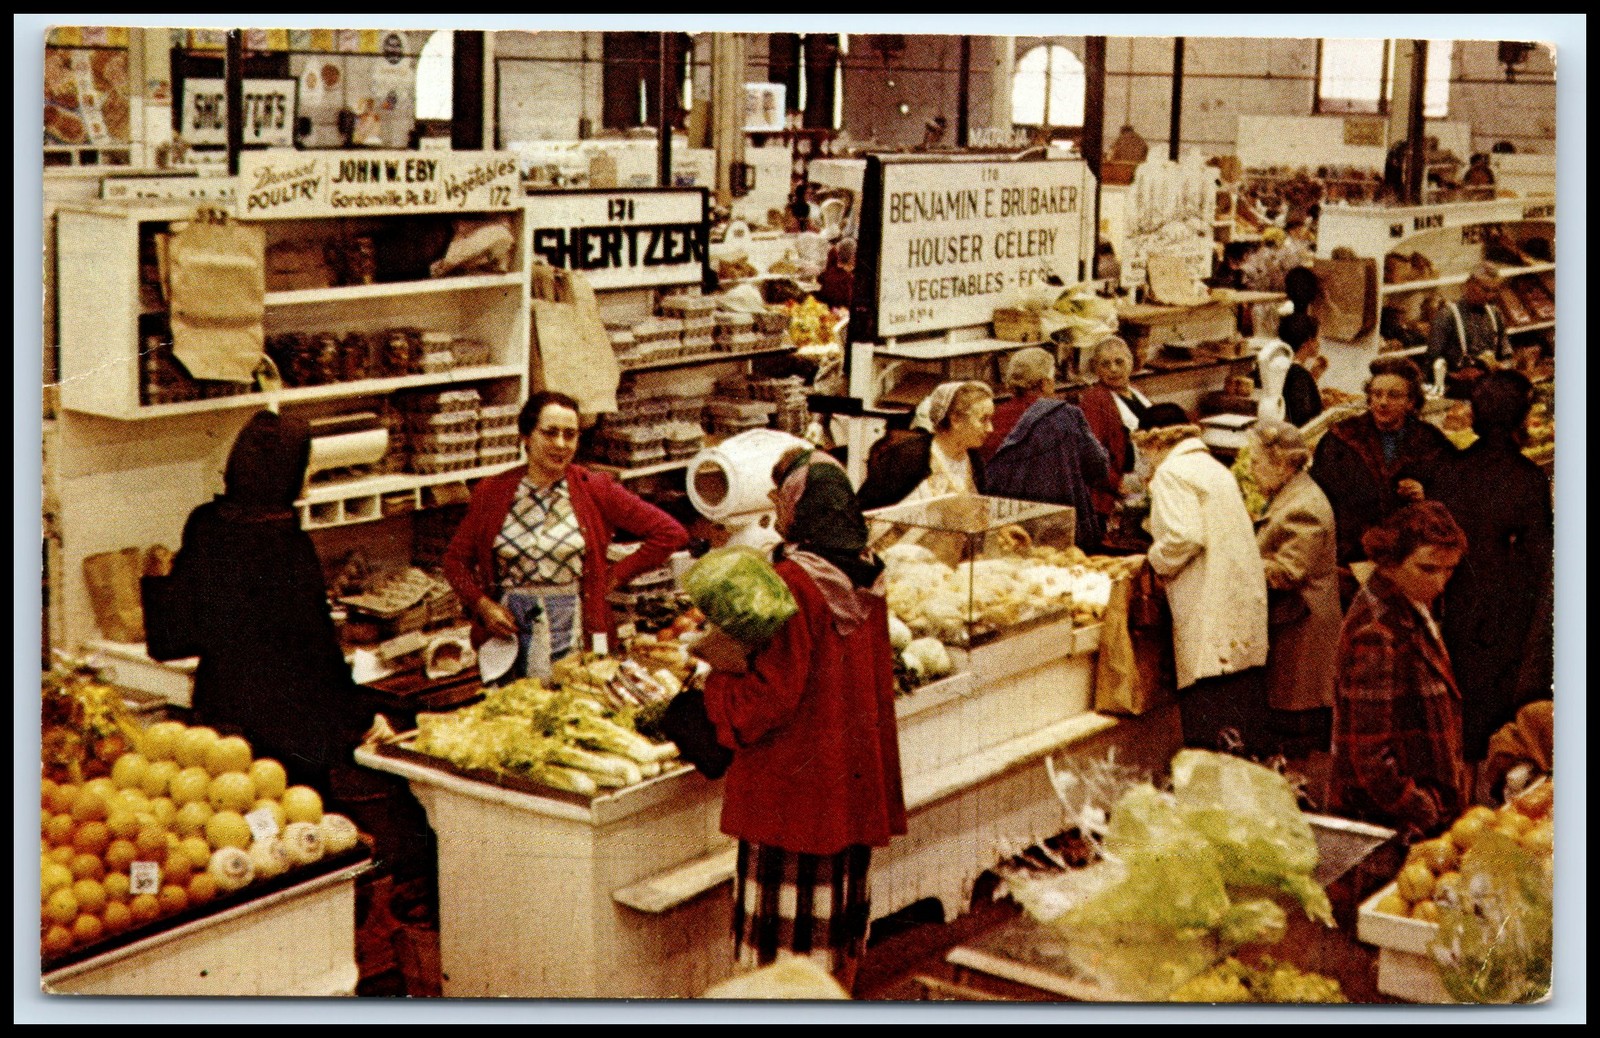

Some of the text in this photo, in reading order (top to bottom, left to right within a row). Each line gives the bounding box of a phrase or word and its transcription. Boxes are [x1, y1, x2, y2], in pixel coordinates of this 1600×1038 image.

[331, 158, 381, 183] JOHN
[405, 157, 438, 183] EBY
[444, 158, 516, 208] Vegetables
[246, 176, 321, 213] POULTRY
[489, 185, 512, 207] 172
[889, 188, 979, 224] BENJAMIN
[1000, 185, 1078, 218] BRUBAKER
[907, 227, 1058, 269] HOUSER CELERY
[907, 271, 1004, 302] VEGETABLES
